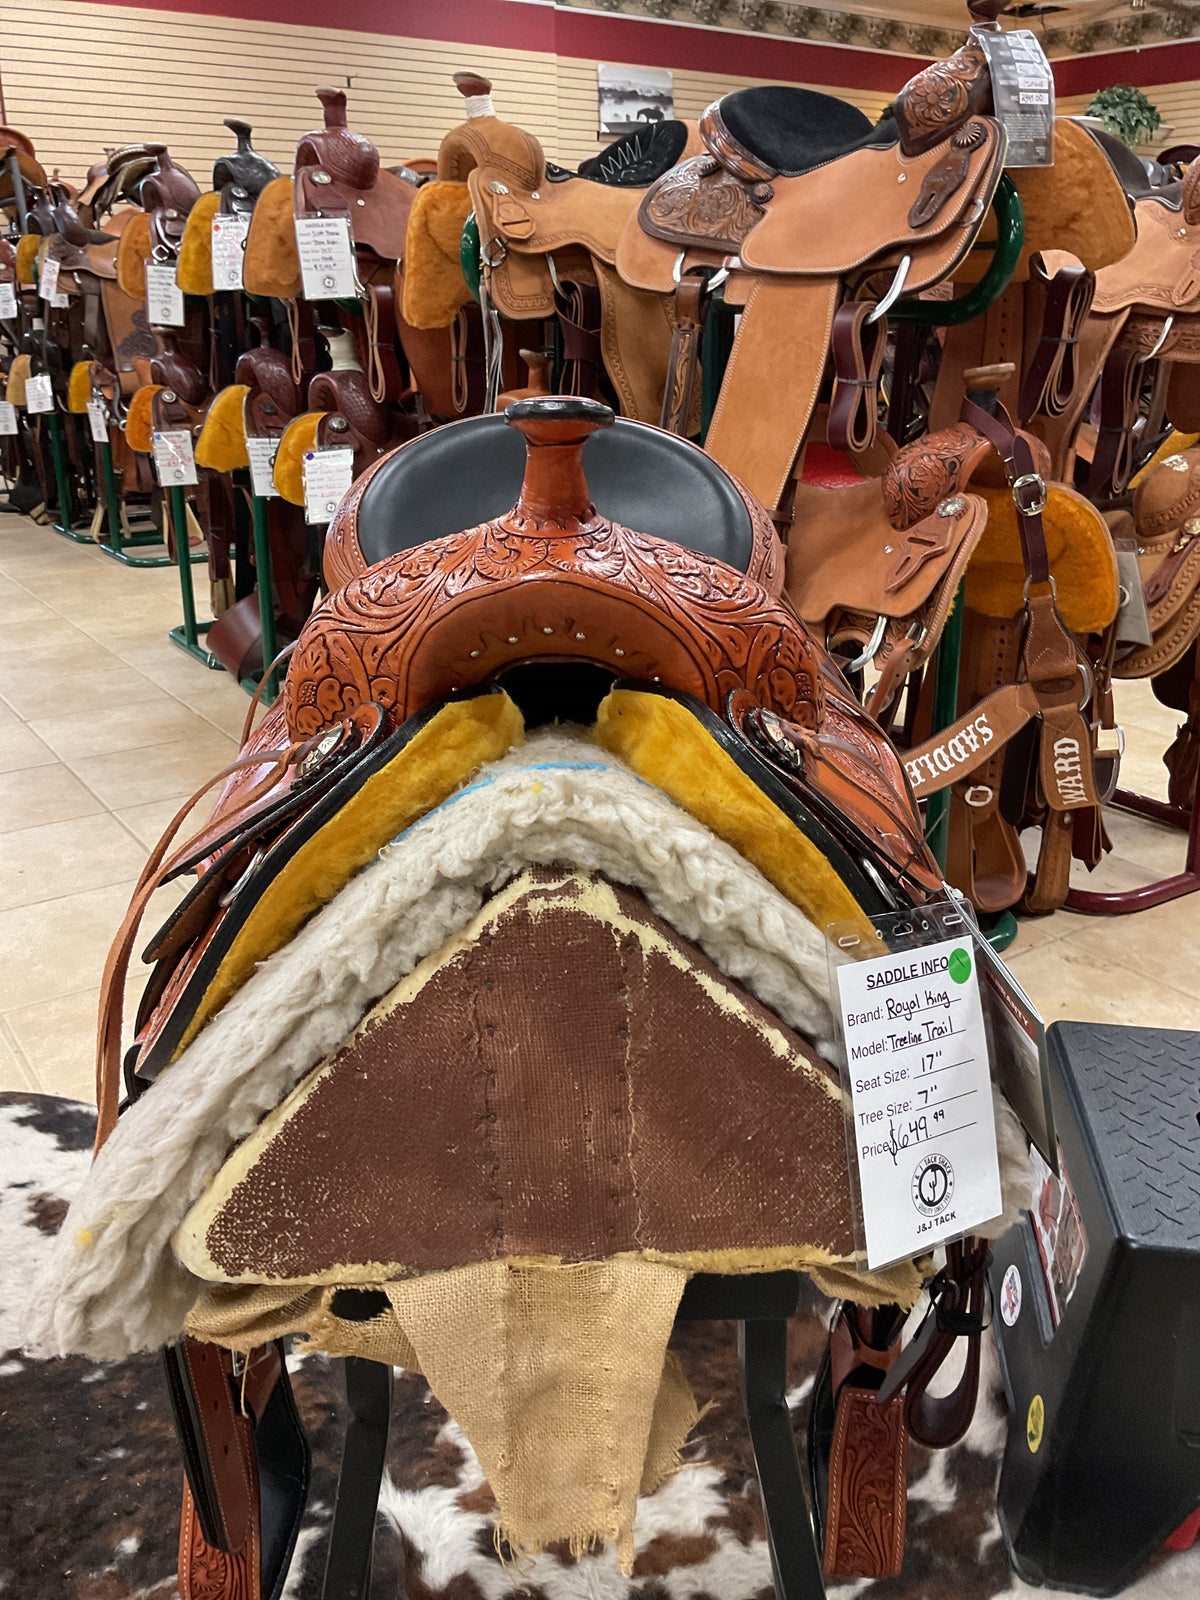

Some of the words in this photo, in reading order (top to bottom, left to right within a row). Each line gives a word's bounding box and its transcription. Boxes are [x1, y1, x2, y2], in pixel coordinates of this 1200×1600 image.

[904, 712, 994, 789] SADDLE
[1053, 737, 1089, 806] WARD
[866, 963, 919, 990] SADDLE
[921, 956, 949, 975] INFO
[847, 1006, 884, 1027] Brand:
[885, 993, 921, 1022] Royal
[924, 989, 951, 1009] King
[851, 1038, 889, 1060] Model:
[886, 1030, 923, 1050] Treeline
[921, 1015, 953, 1041] Trail
[855, 1076, 882, 1093] Seat
[883, 1067, 910, 1085] Size:
[921, 1050, 942, 1073] 17"
[858, 1110, 884, 1127] Tree
[886, 1100, 912, 1118] Size:
[917, 1084, 937, 1104] 7"
[924, 1155, 938, 1166] TACK
[938, 1156, 952, 1176] SHACK
[916, 1220, 933, 1234] J&J
[934, 1211, 957, 1227] TACK
